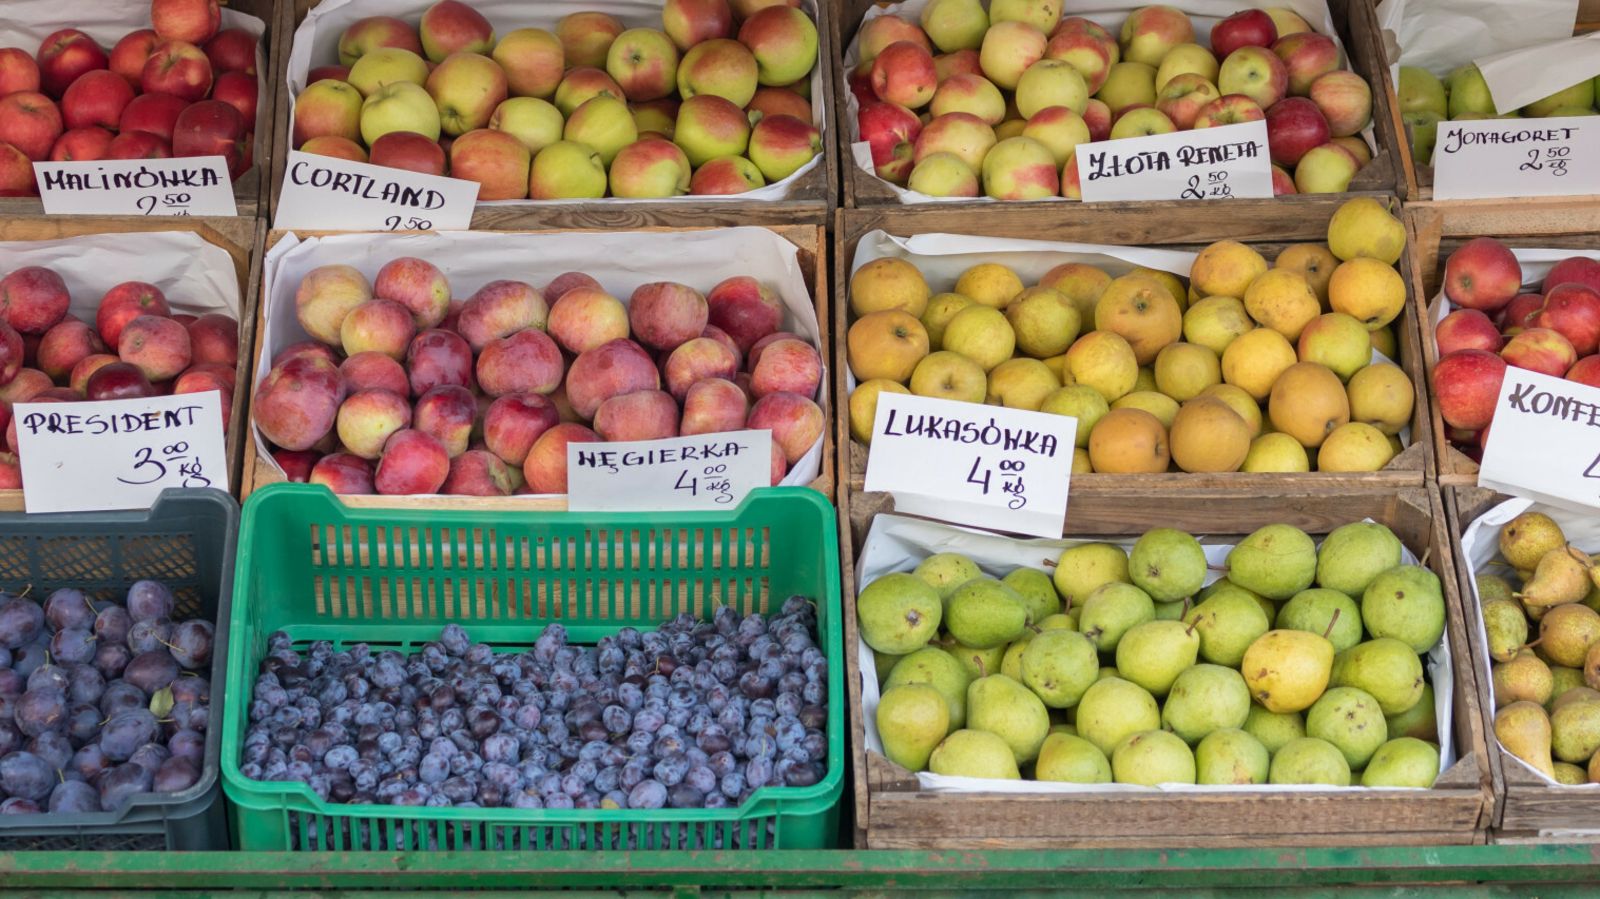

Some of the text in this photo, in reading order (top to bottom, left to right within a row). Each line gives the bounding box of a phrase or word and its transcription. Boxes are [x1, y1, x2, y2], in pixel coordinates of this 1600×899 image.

[1088, 140, 1263, 181] ZŁOTA RENETA
[1519, 149, 1543, 171] 2
[1546, 146, 1570, 158] 50
[162, 193, 191, 205] 50
[290, 161, 445, 210] CORTLAND
[1180, 175, 1205, 199] 2
[1208, 171, 1228, 182] 50
[404, 217, 433, 230] 50
[23, 406, 203, 434] PRESIDENT
[884, 409, 1058, 457] LUKASÓWKA
[117, 441, 211, 488] 3 00 kg
[578, 442, 749, 474] WĘGIERKA
[674, 469, 697, 496] 4
[703, 464, 727, 476] 00
[967, 456, 1027, 510] 4 00 kg
